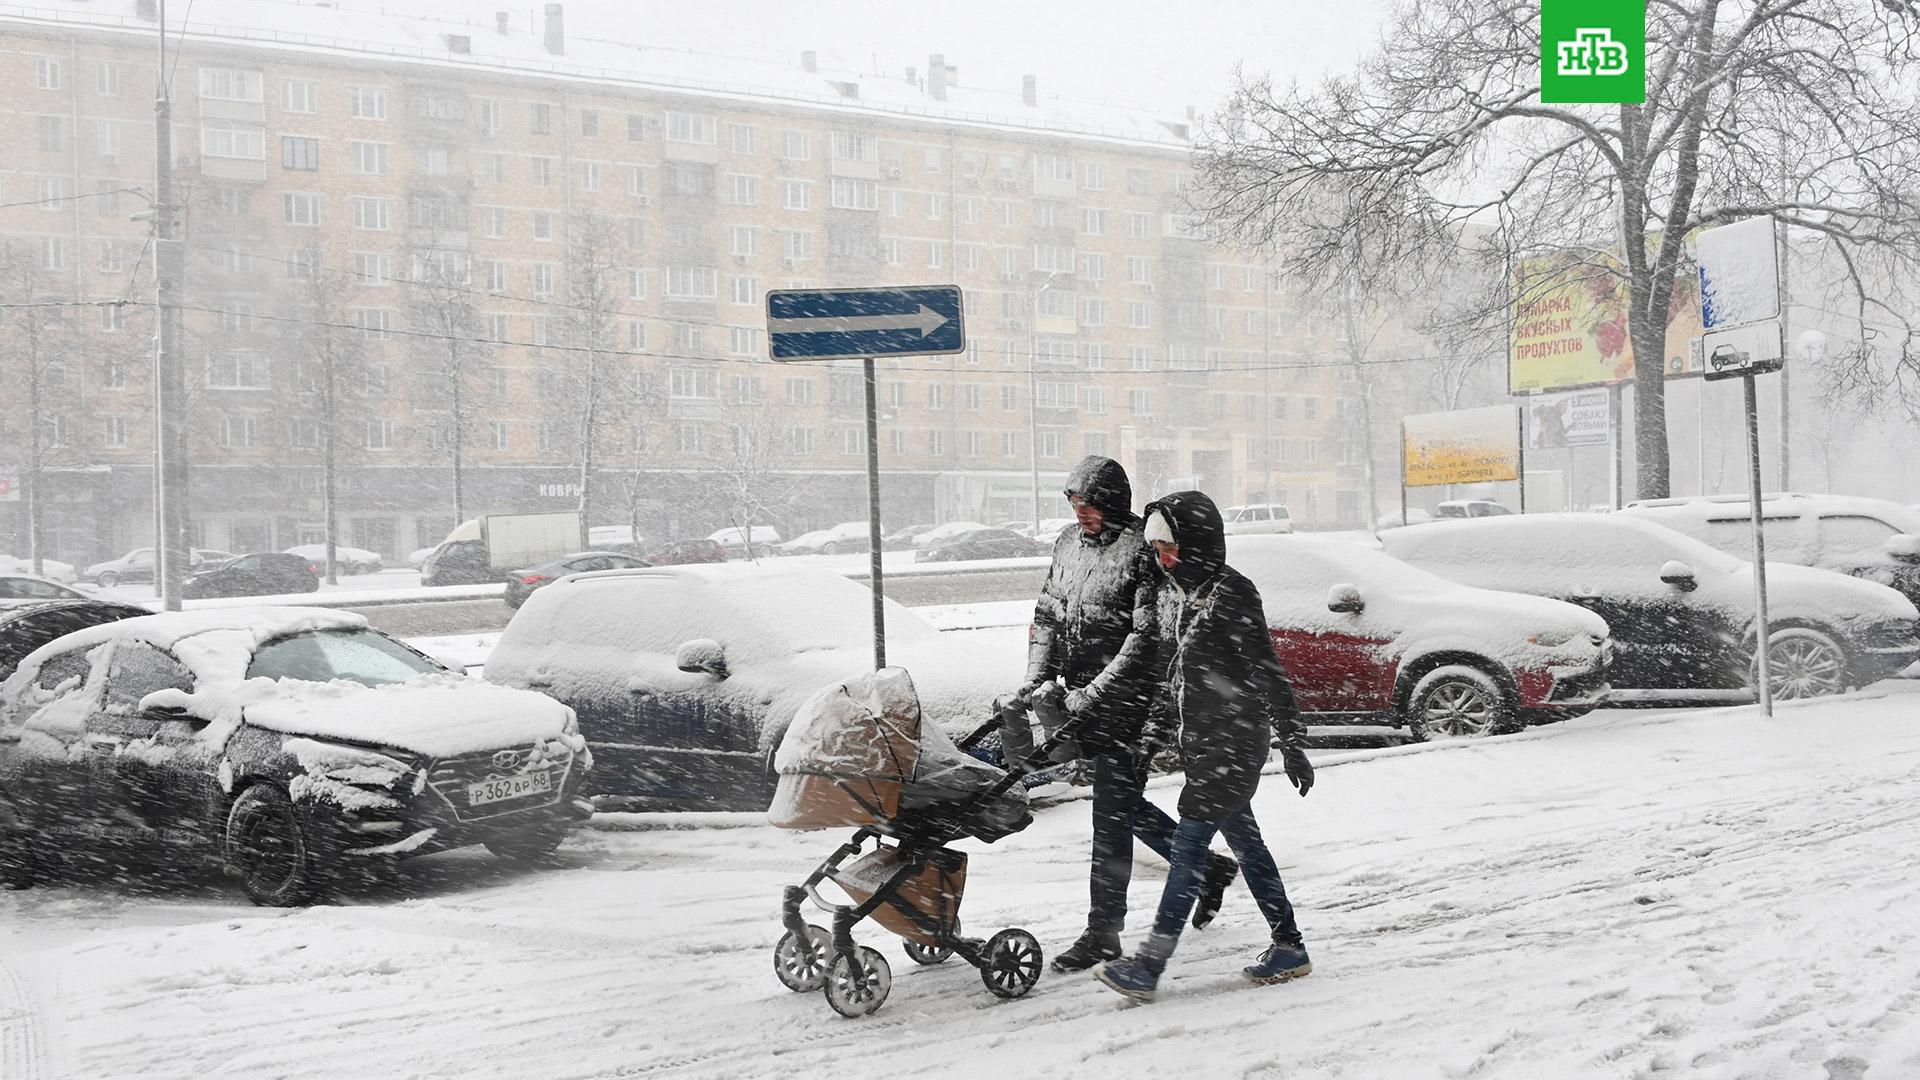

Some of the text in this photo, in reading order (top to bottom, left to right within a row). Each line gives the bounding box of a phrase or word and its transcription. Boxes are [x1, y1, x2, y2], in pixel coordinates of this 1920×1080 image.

[1517, 317, 1572, 339] ВКУСНЫХ
[1516, 338, 1583, 360] ПРОДУКТОВ
[1571, 409, 1607, 420] СОБАКУ
